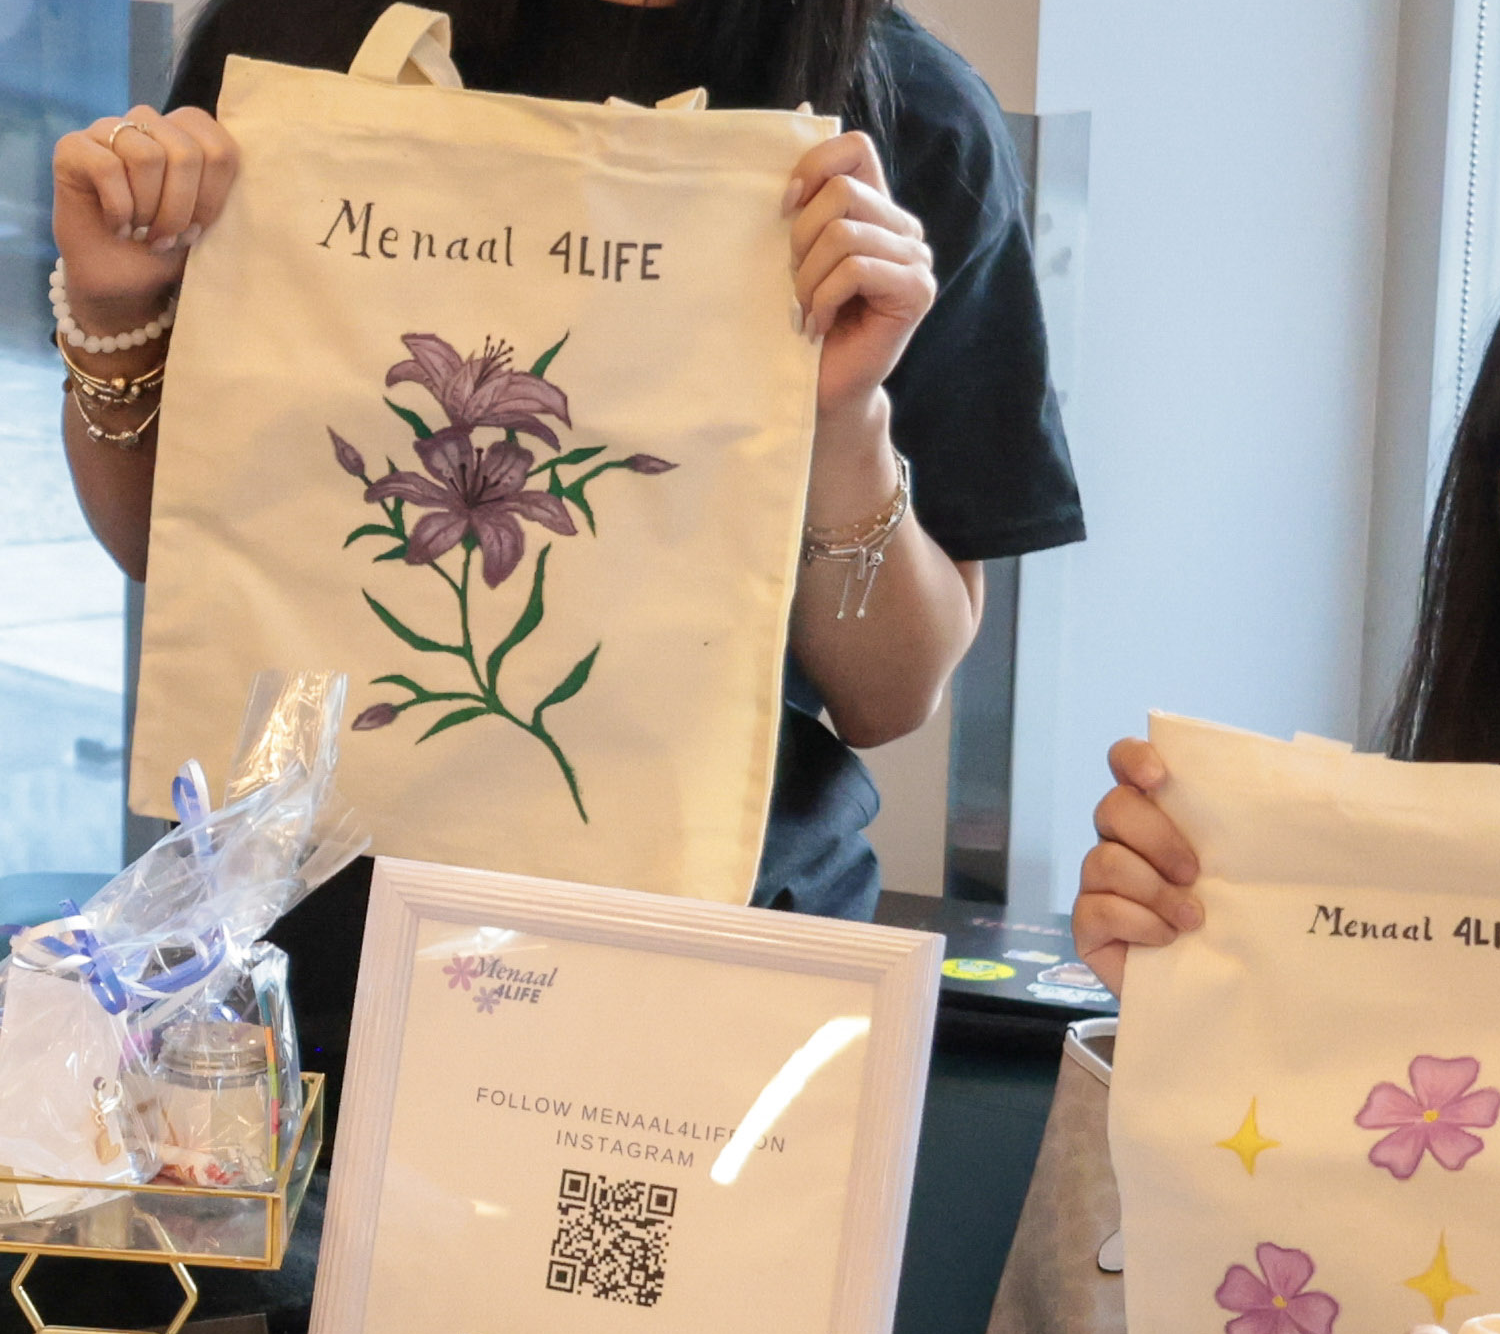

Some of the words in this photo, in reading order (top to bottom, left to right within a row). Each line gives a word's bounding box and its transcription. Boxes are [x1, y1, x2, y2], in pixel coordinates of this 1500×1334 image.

[316, 198, 514, 267] Menaal
[549, 231, 664, 283] 4LIFE
[1306, 904, 1433, 941] Menaal
[471, 955, 559, 988] Menaal
[493, 984, 542, 1004] 4LIFE
[476, 1087, 572, 1118] FOLLOW
[556, 1129, 695, 1168] INSTAGRAM
